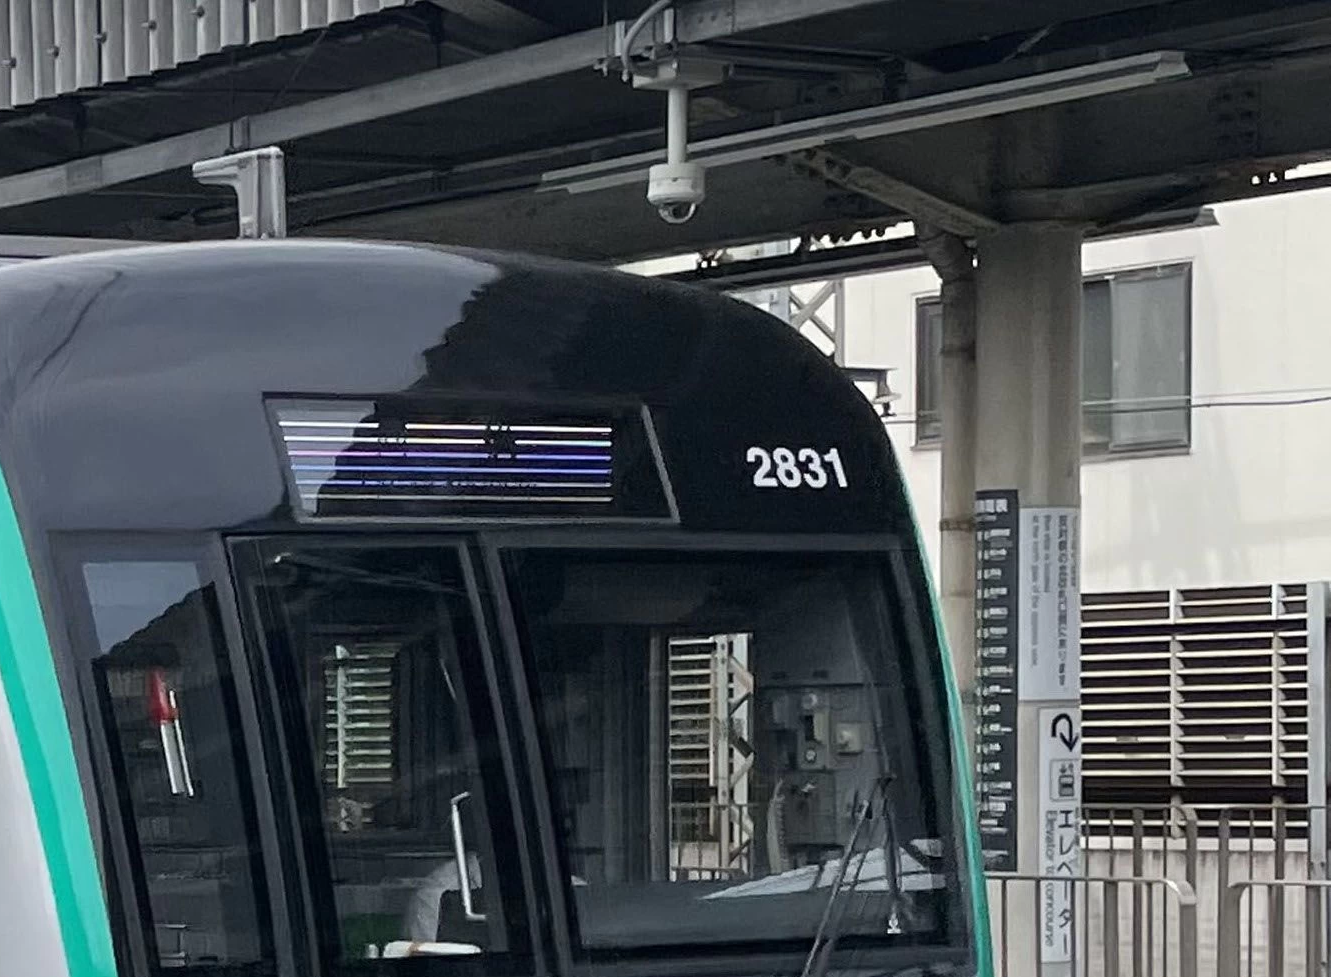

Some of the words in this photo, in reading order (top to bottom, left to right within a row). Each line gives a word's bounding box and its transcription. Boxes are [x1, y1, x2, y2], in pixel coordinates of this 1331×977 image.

[746, 446, 848, 488] 2831
[1045, 810, 1057, 861] Elevator
[1045, 882, 1055, 947] concourse
